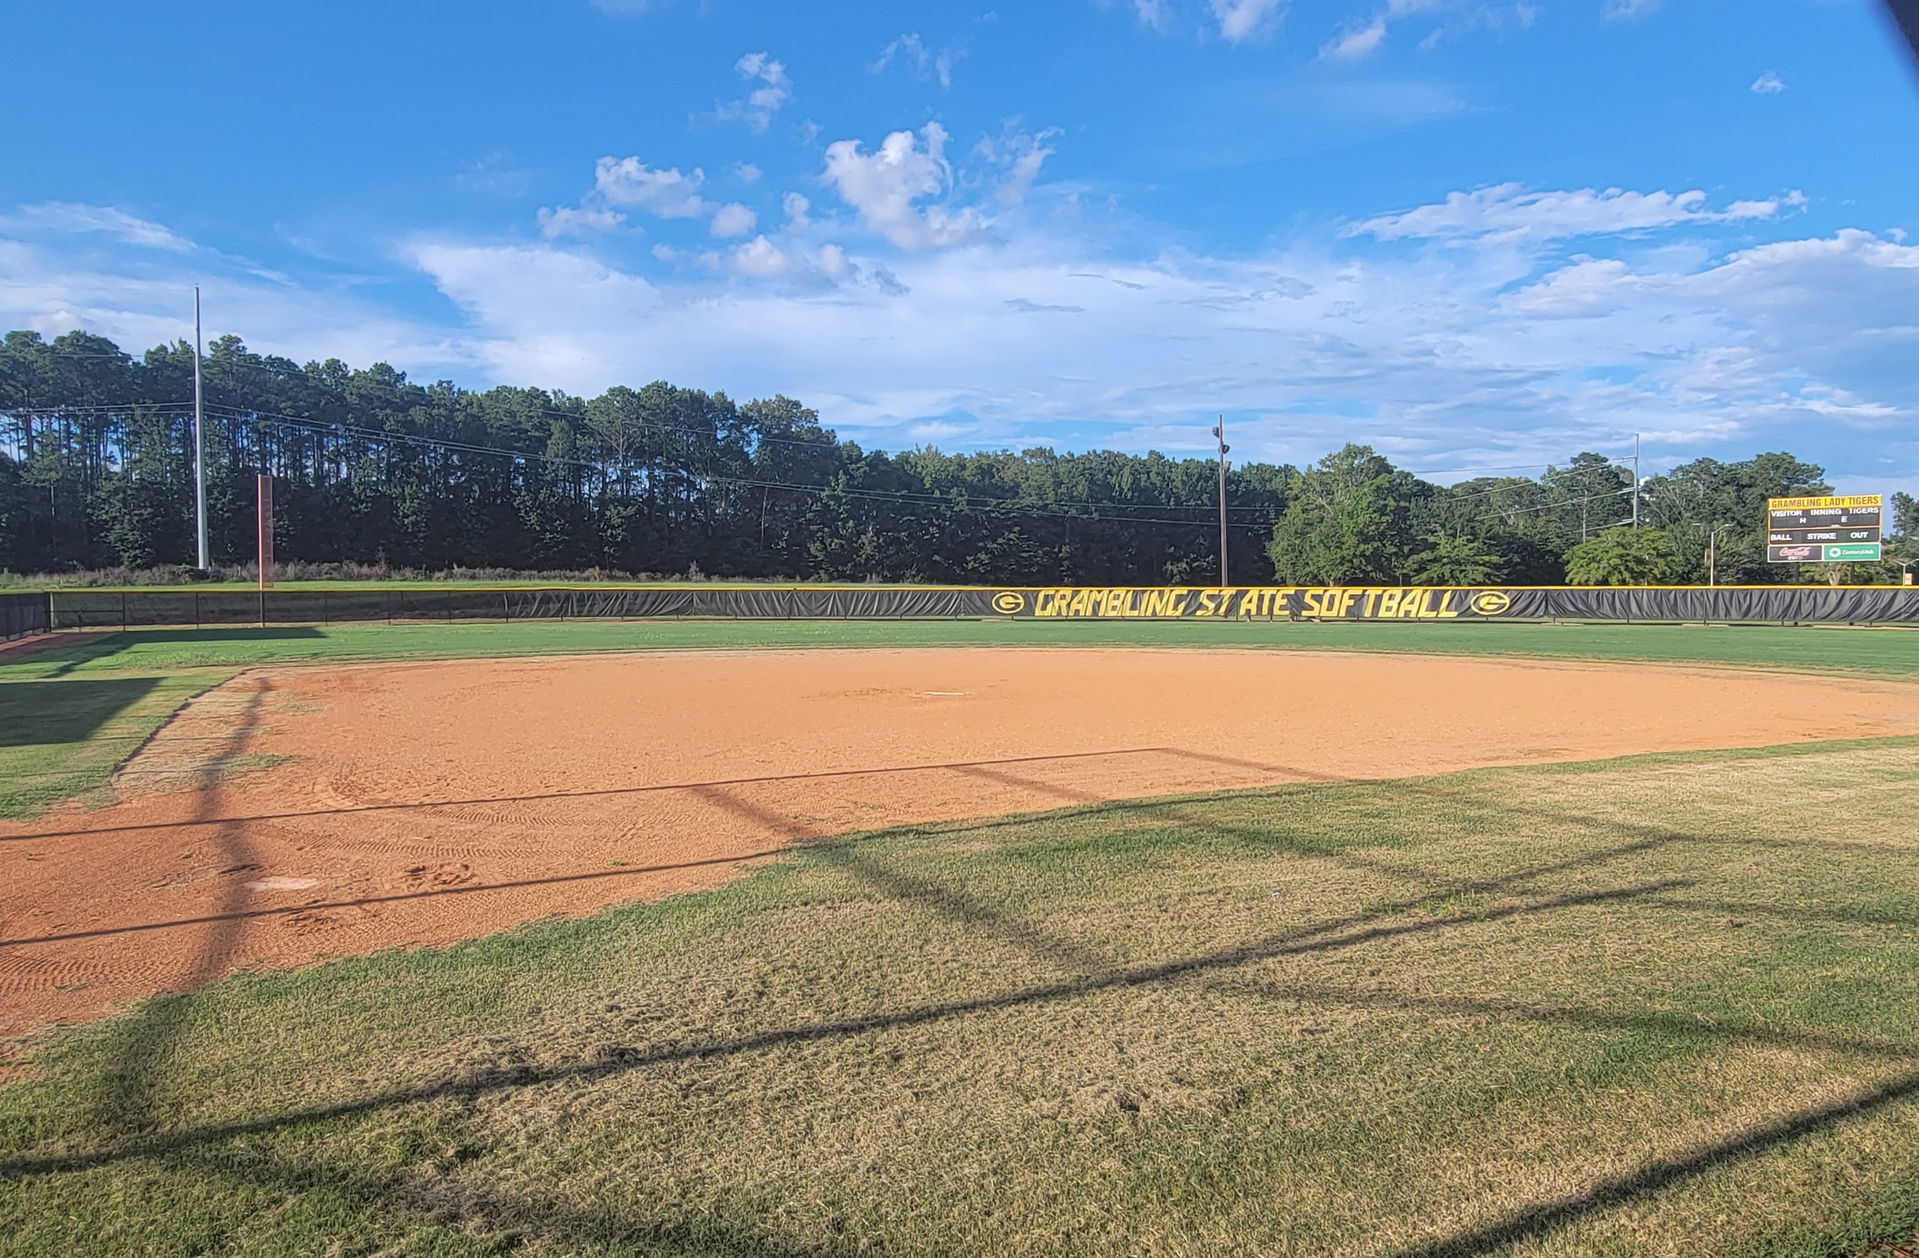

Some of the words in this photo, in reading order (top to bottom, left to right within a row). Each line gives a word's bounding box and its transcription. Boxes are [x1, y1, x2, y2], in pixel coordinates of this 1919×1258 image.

[1772, 499, 1821, 508] GRAMBLING
[1824, 498, 1845, 506] LADY
[1848, 496, 1879, 505] TIGERS
[1810, 508, 1842, 516] INNING
[1034, 589, 1188, 617] GRAMBLING
[1301, 589, 1459, 617] SOFTBALL
